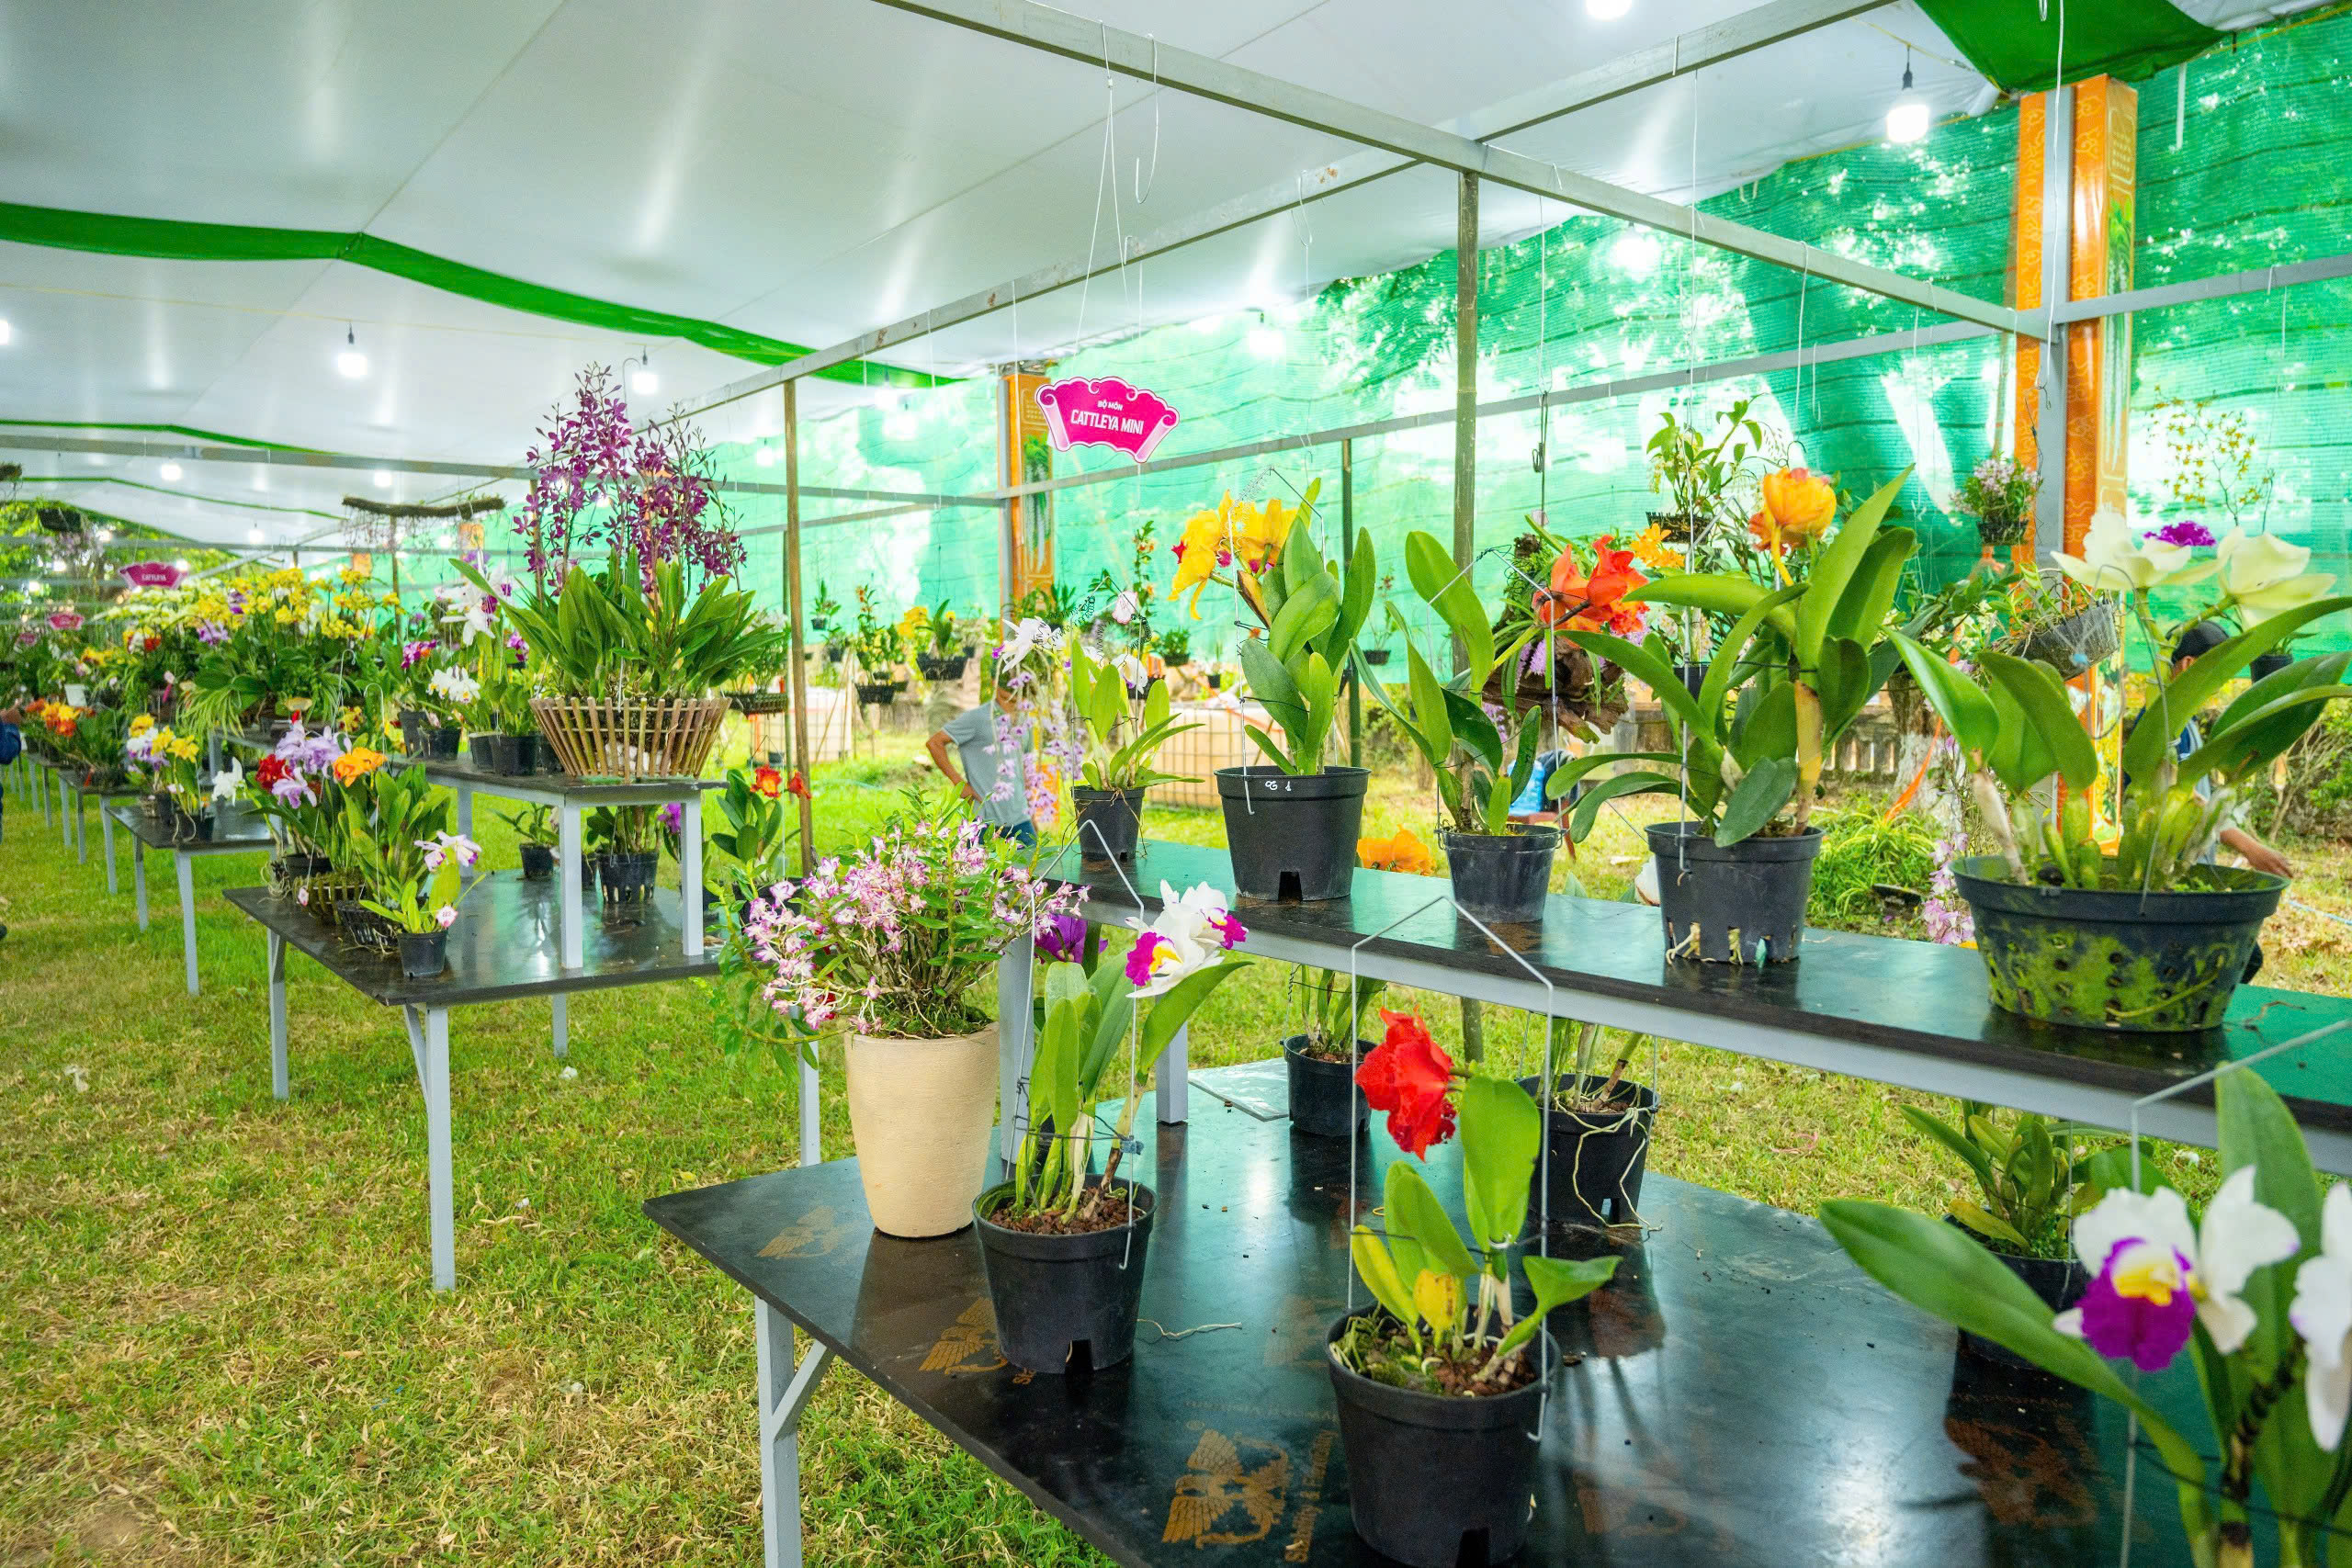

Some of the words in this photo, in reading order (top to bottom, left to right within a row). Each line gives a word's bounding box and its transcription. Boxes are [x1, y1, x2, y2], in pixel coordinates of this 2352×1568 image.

[1097, 399, 1108, 410] BỘ
[1108, 401, 1124, 412] MÔN
[1070, 409, 1119, 431] CATTLEYA
[1121, 418, 1145, 435] MINI
